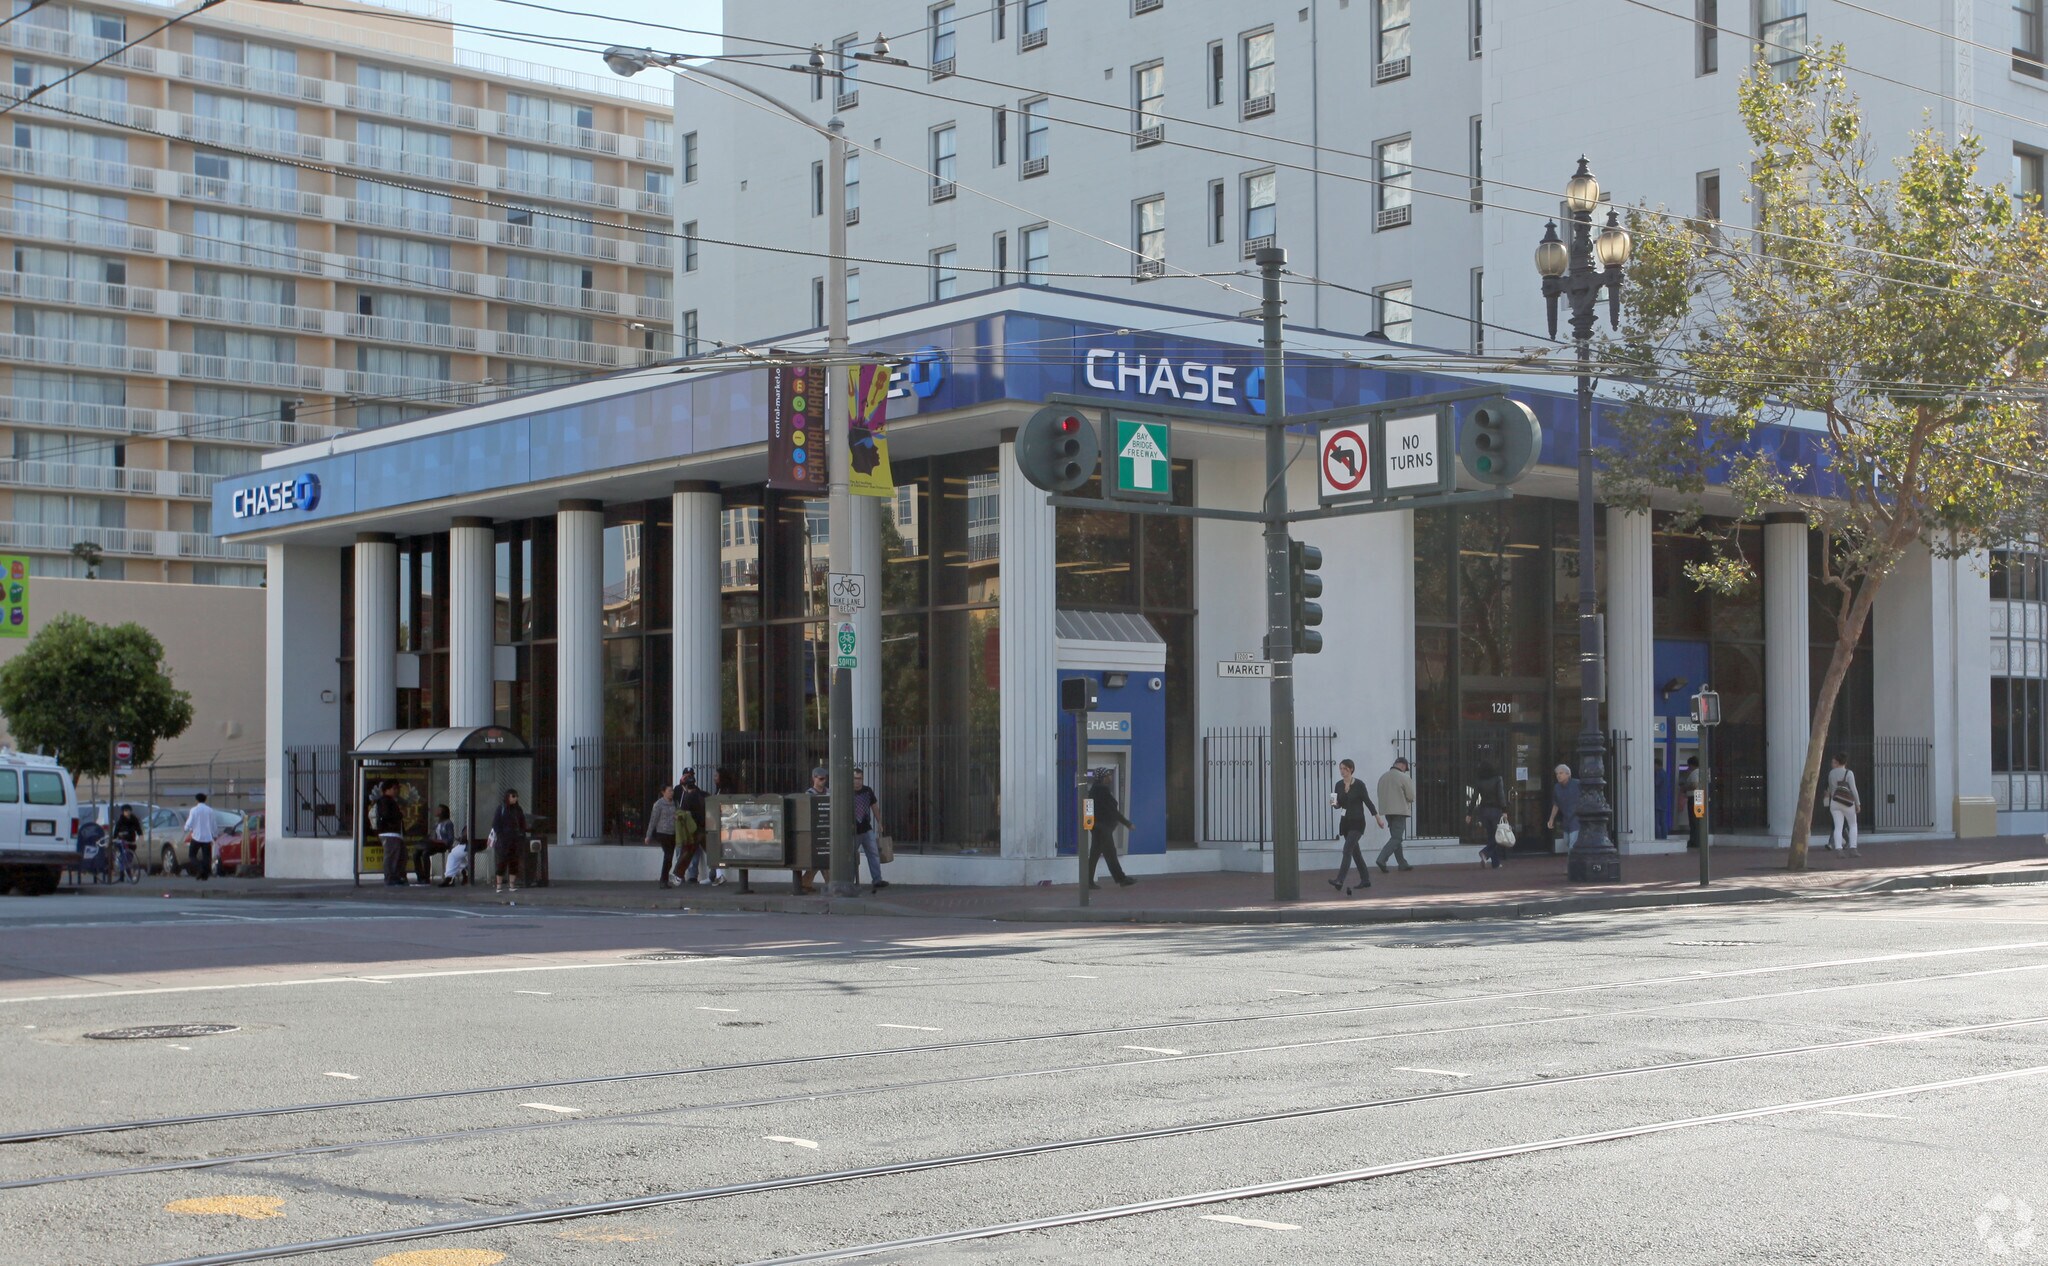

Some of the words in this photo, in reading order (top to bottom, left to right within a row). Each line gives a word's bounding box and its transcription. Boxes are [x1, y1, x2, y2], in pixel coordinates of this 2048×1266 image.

[1086, 349, 1237, 406] CHASE
[1132, 441, 1153, 450] BRIDGE
[1402, 434, 1419, 450] NO
[808, 424, 825, 484] CENTRAL
[1127, 449, 1158, 458] FREEWAY
[1390, 452, 1433, 471] TURNS
[233, 480, 294, 518] CHASE
[833, 597, 845, 605] BIKE
[847, 598, 861, 606] LANE
[842, 643, 852, 653] 23
[838, 658, 856, 667] SOUTH
[1227, 664, 1265, 675] MARKET
[1491, 702, 1511, 714] 1201
